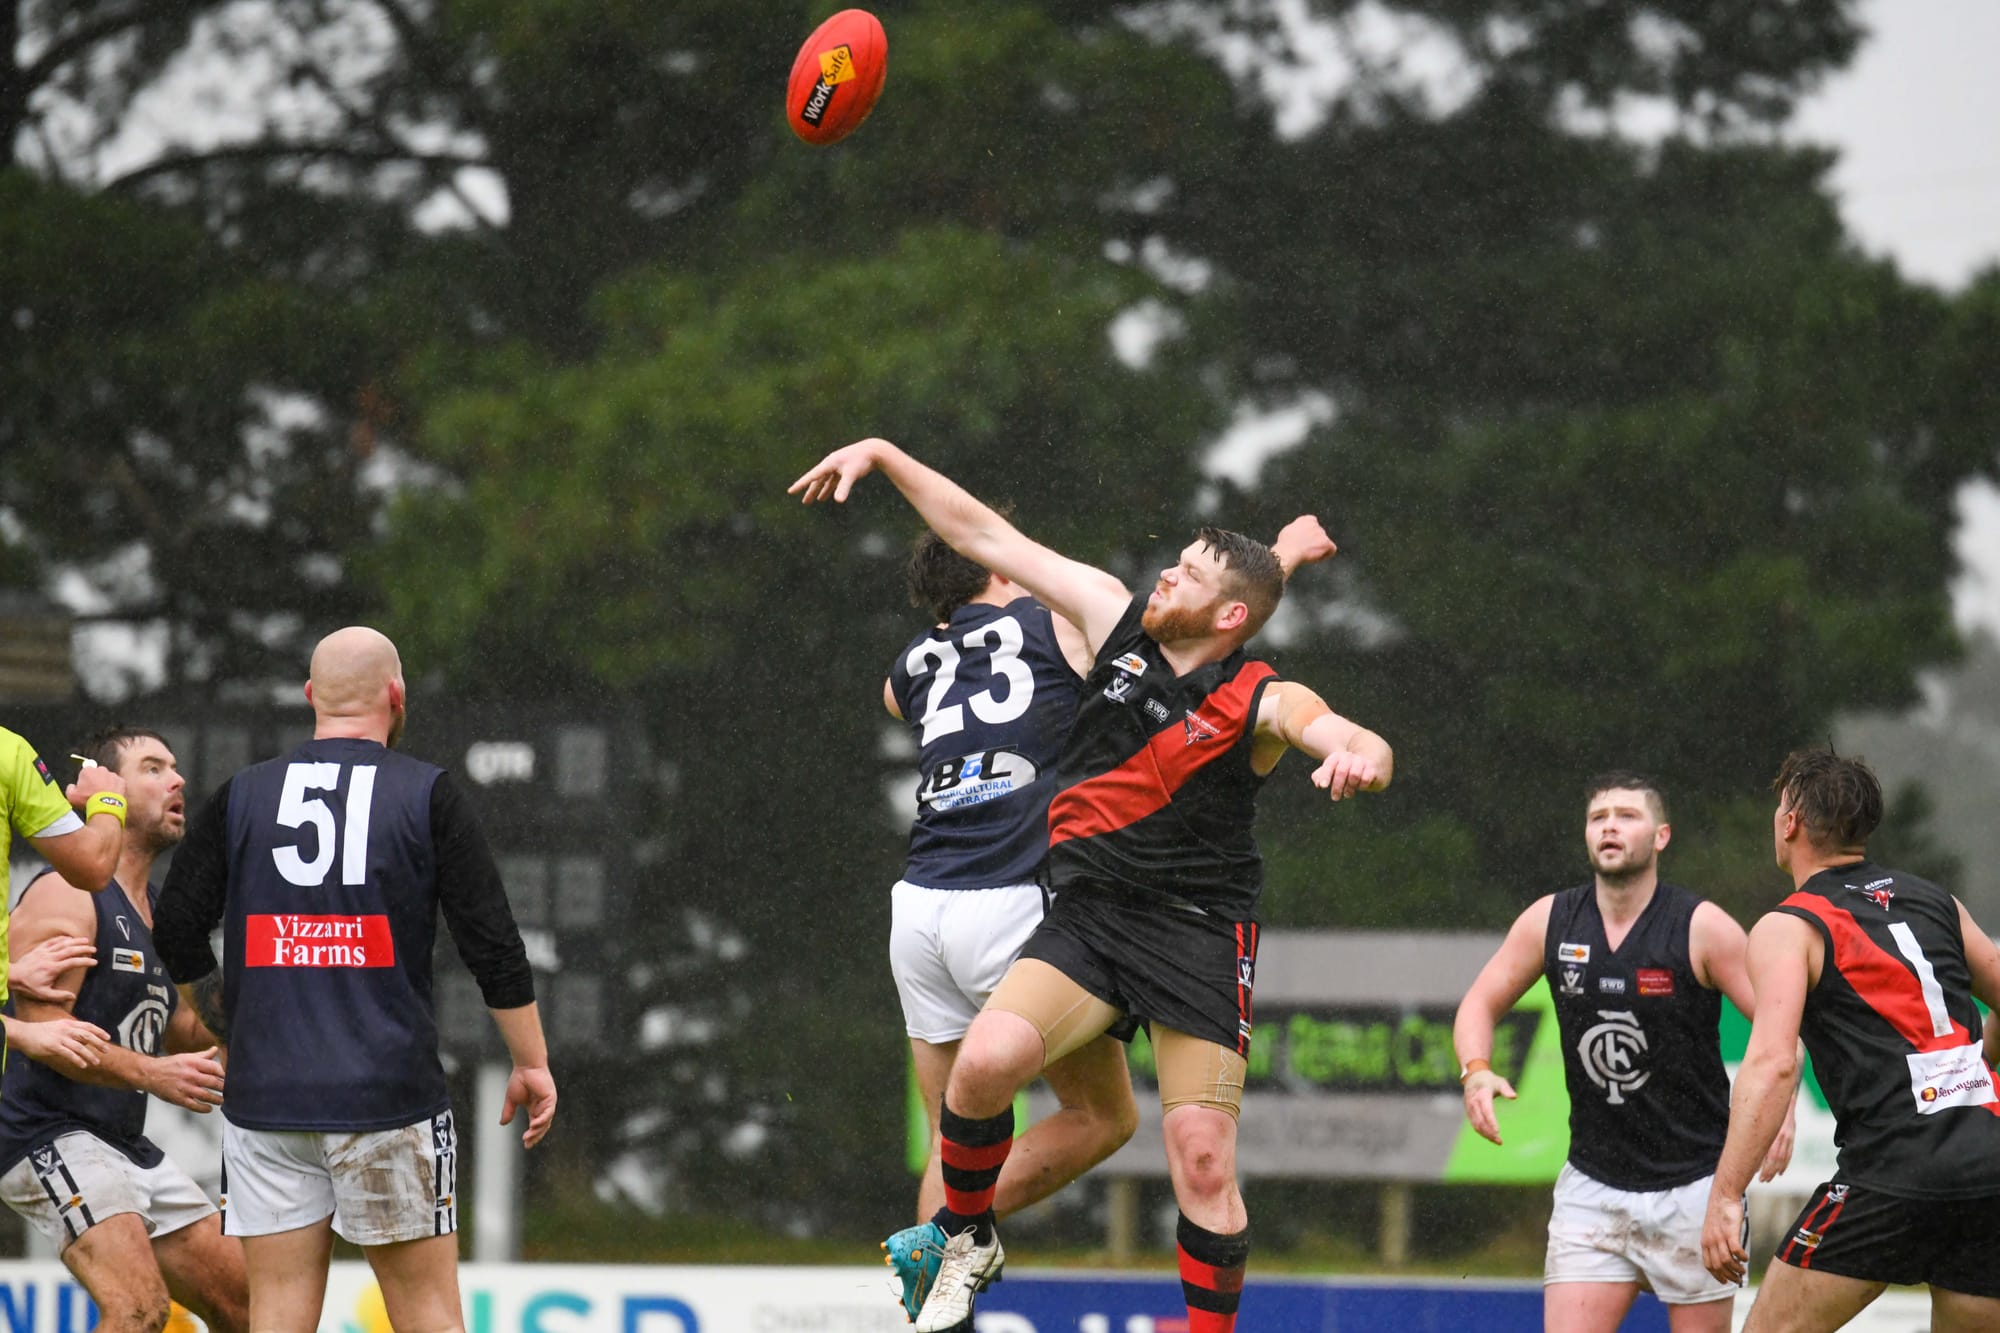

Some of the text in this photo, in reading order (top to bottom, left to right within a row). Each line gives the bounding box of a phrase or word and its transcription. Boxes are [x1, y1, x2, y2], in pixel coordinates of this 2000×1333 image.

[804, 50, 848, 120] Work Safe
[906, 615, 1035, 747] 23
[1147, 700, 1169, 719] SWD
[936, 780, 1013, 800] AGRICULTURAL
[272, 761, 377, 886] 51
[272, 937, 366, 966] Farms
[273, 916, 363, 938] Vizzarri
[1887, 921, 1955, 1038] 1
